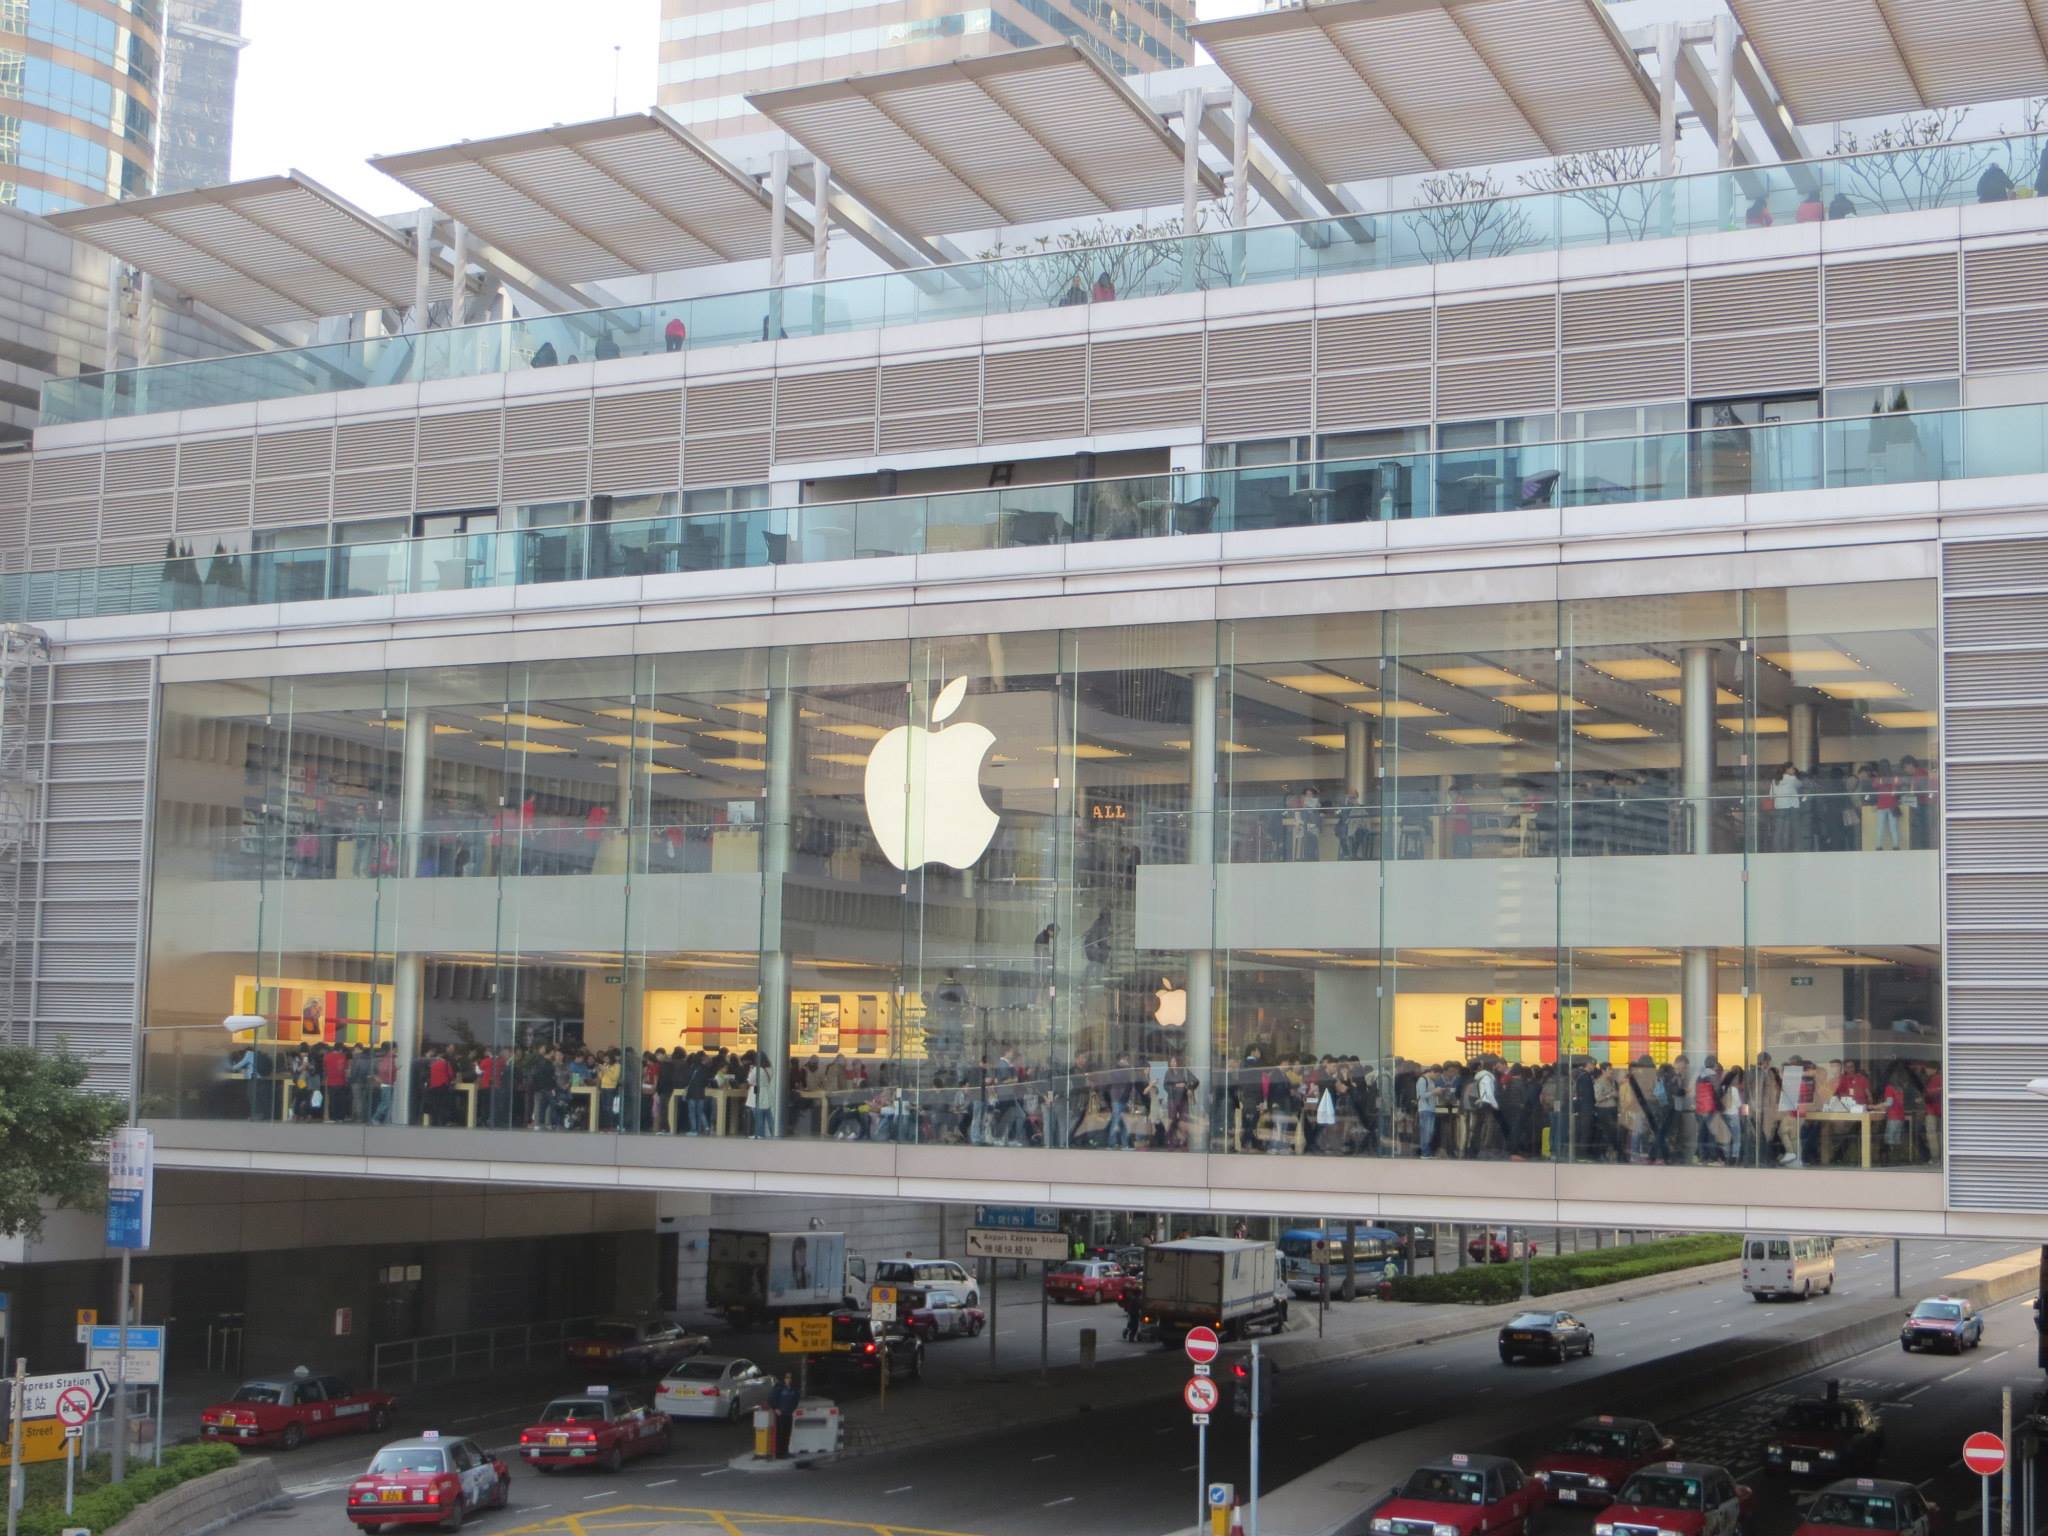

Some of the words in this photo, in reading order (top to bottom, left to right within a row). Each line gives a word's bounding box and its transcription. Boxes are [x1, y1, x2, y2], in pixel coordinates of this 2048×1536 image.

[1093, 805, 1127, 818] ALL
[1010, 1234, 1038, 1243] Express
[23, 1382, 54, 1393] xpress
[56, 1378, 91, 1388] Station
[26, 1426, 53, 1438] Street
